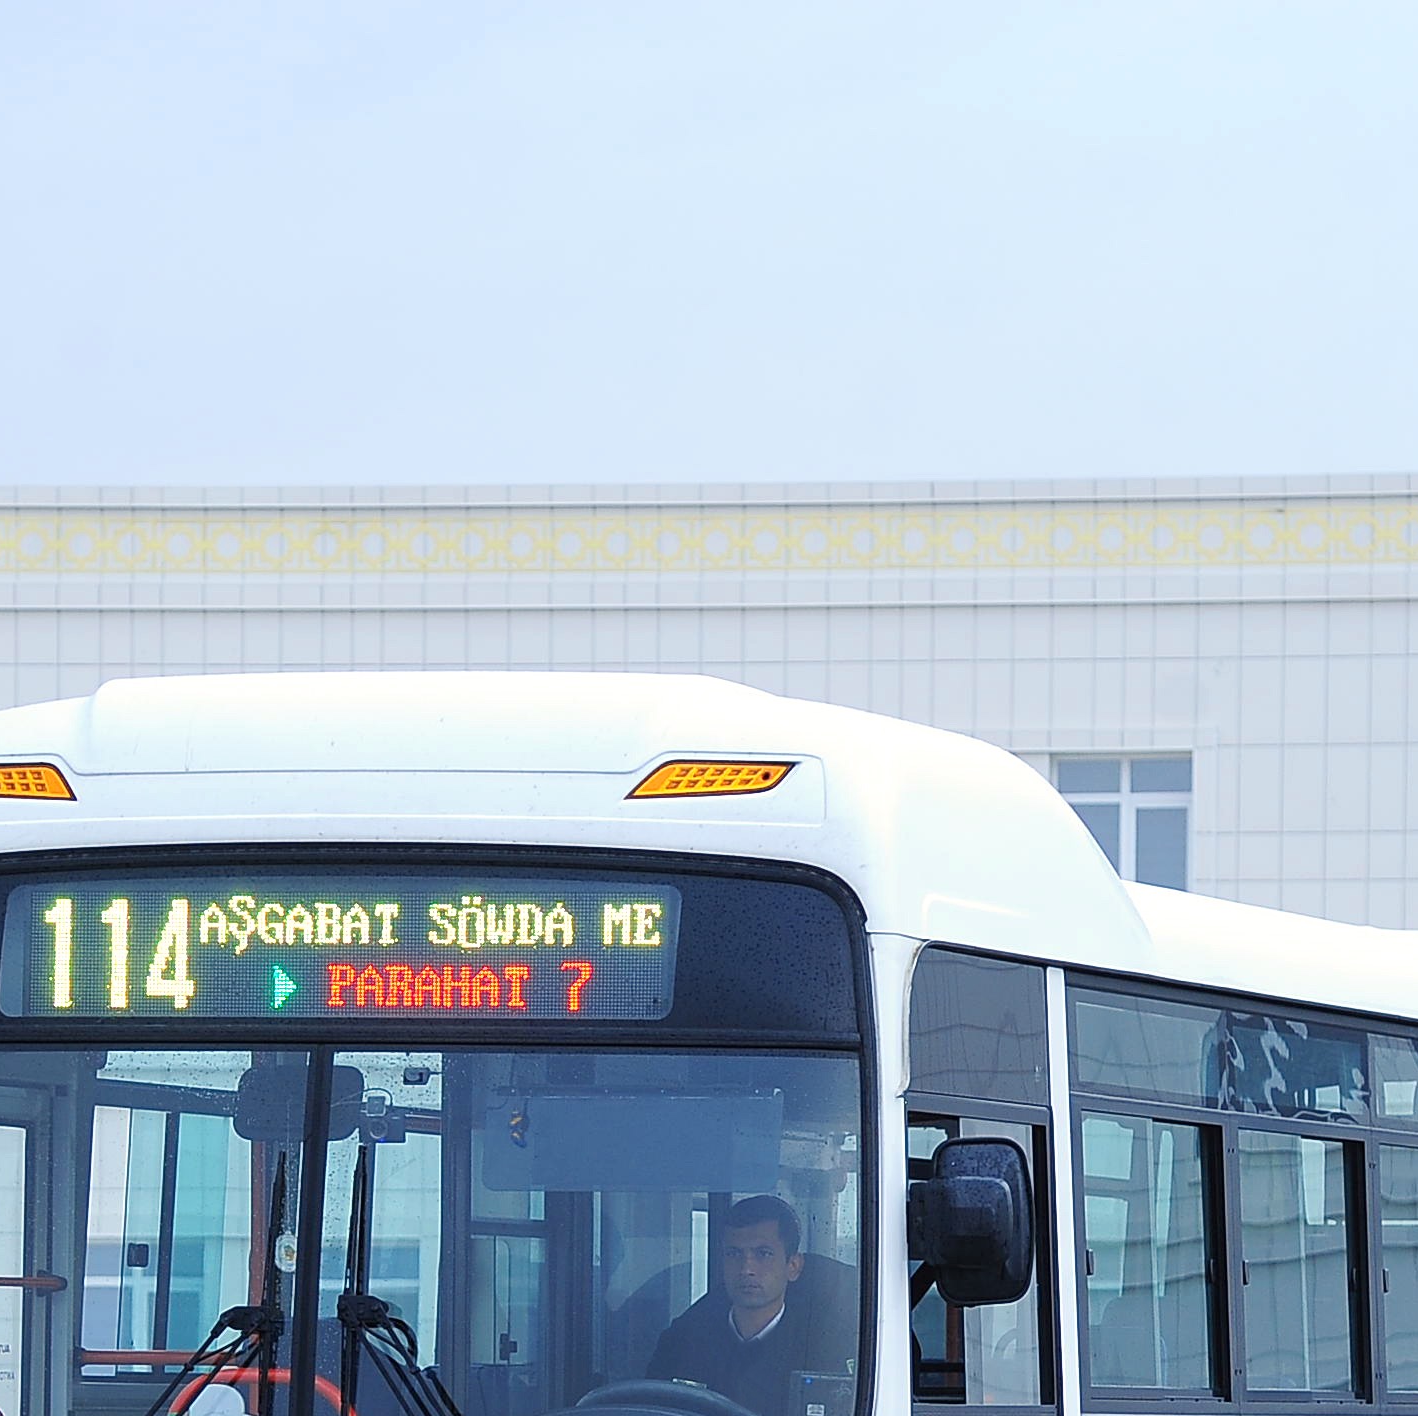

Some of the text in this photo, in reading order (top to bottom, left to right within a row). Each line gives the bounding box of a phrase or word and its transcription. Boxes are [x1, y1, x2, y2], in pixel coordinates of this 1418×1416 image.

[43, 897, 196, 1010] 114
[200, 895, 663, 954] AŞGABAT SÖWDA ME
[325, 961, 593, 1013] PARAHAT 7
